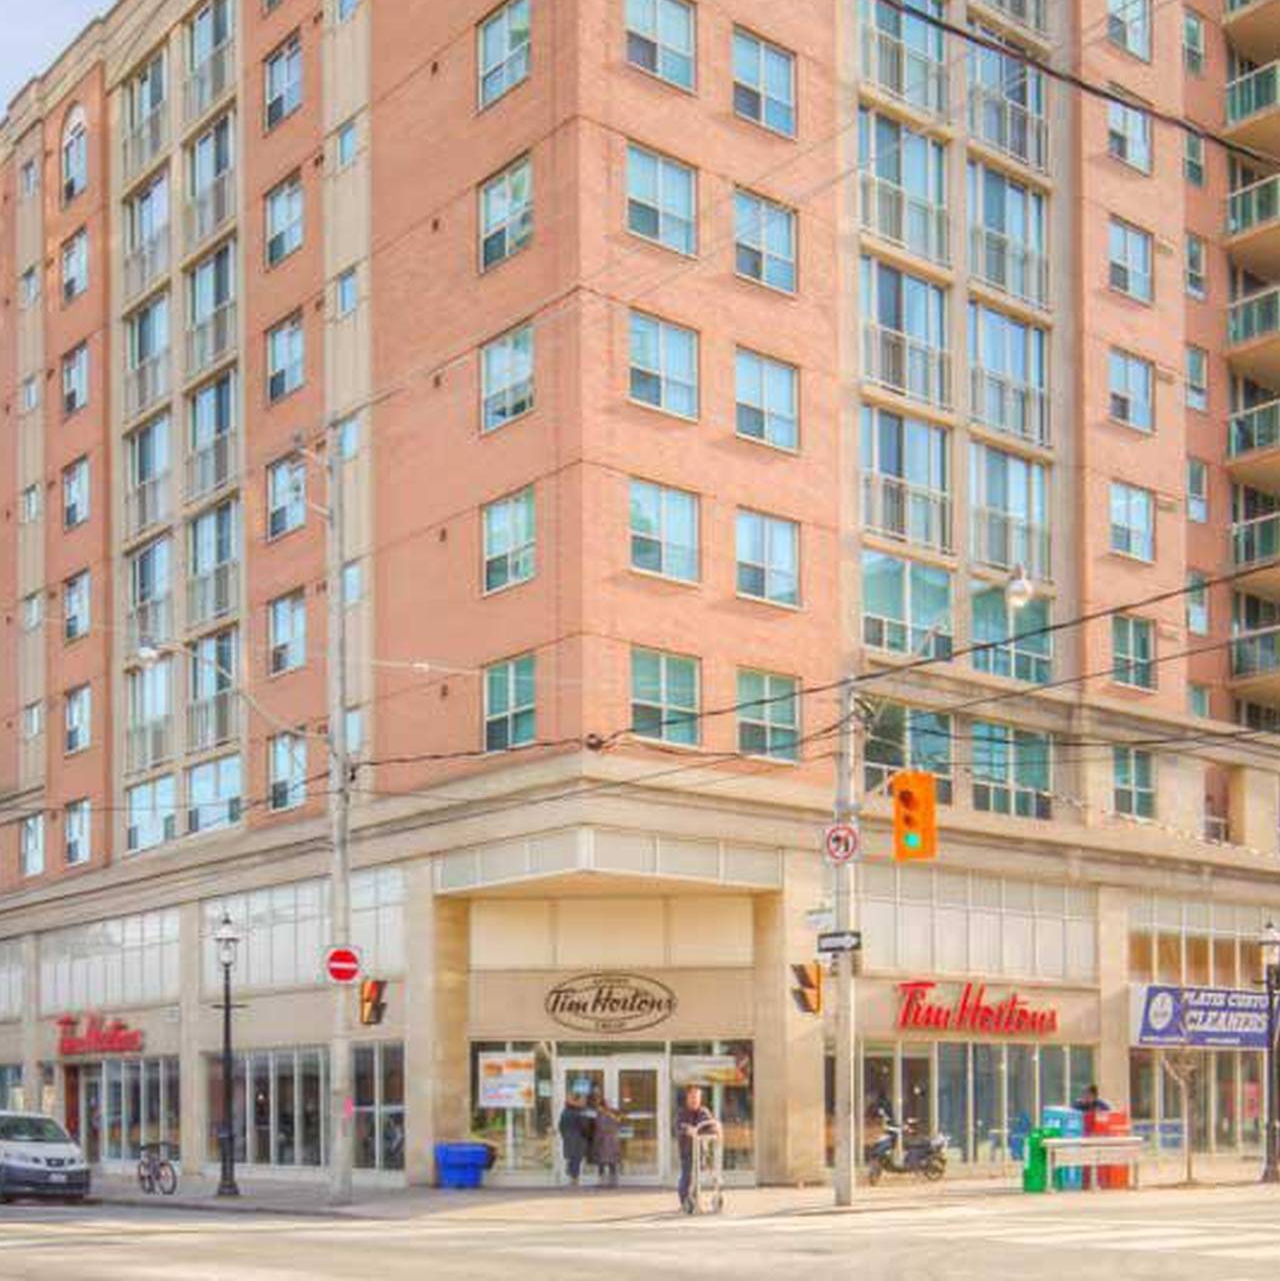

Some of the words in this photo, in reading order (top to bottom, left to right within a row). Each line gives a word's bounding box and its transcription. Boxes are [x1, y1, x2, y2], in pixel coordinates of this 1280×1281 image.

[550, 988, 587, 1013] Tim
[590, 987, 674, 1013] Hortons
[898, 982, 951, 1029] Tim
[955, 982, 1058, 1035] Hortons
